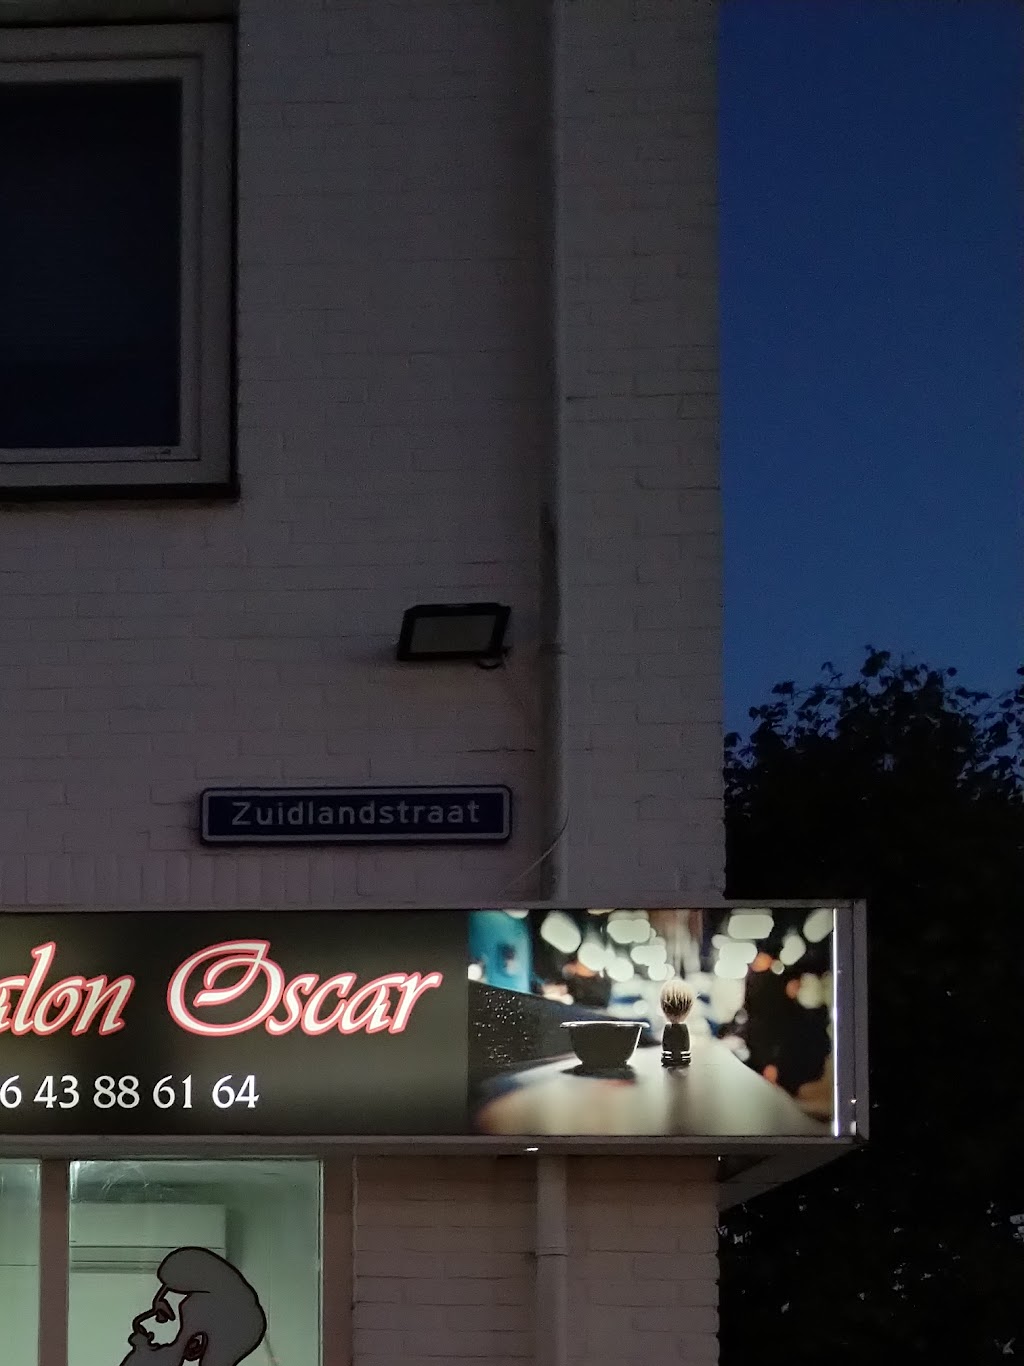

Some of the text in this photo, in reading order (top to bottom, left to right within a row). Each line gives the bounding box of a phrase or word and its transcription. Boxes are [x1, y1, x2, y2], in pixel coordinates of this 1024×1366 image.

[231, 799, 481, 826] Zuidlandstraat
[167, 939, 443, 1037] Oscar
[33, 1074, 80, 1109] 43
[93, 1074, 141, 1109] 88
[152, 1074, 194, 1109] 61
[211, 1074, 261, 1109] 64
